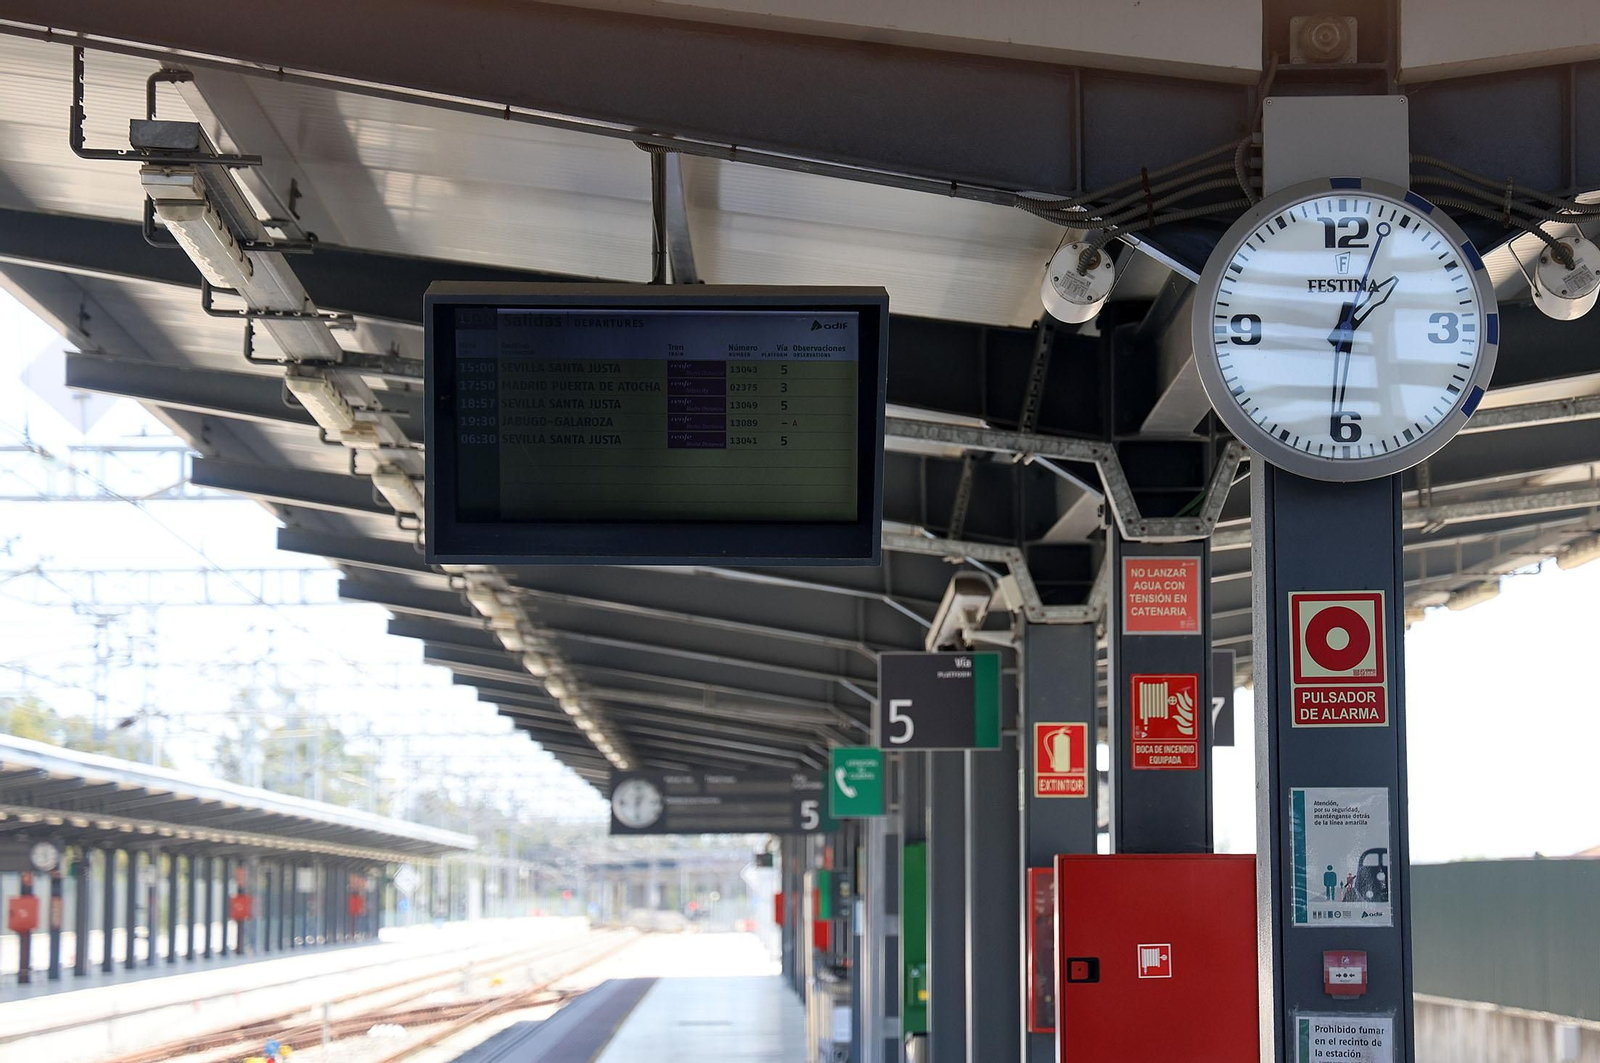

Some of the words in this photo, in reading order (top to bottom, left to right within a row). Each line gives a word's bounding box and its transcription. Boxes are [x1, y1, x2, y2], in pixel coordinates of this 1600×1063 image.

[1317, 217, 1369, 249] 12
[1307, 278, 1380, 293] FESTINA
[503, 312, 562, 327] Salidas
[574, 319, 644, 328] DEPARTURES
[1230, 314, 1262, 345] 9
[1428, 312, 1459, 344] 3
[668, 343, 685, 351] Tren
[728, 342, 758, 351] Número
[792, 343, 846, 351] Observaciones
[459, 362, 495, 373] 15:00
[501, 363, 545, 374] SEVILLA
[550, 363, 583, 374] SANTA
[587, 363, 621, 374] JUSTA
[730, 366, 758, 374] 13043
[780, 364, 788, 375] 5
[460, 381, 495, 391] 17:50
[502, 381, 548, 391] MADRID
[552, 381, 594, 392] PUERTA
[600, 381, 614, 392] DE
[617, 381, 661, 392] ATOCHA
[730, 383, 758, 391] 02375
[780, 382, 788, 393] 3
[460, 399, 495, 409] 18:57
[501, 399, 545, 409] SEVILLA
[550, 399, 584, 410] SANTA
[588, 399, 622, 410] JUSTA
[730, 402, 758, 410] 13049
[780, 400, 788, 411] 5
[460, 417, 496, 427] 19:30
[502, 417, 613, 428] JABUGO-GALAROZA
[730, 420, 758, 428] 13089
[1330, 411, 1362, 443] 6
[461, 434, 496, 444] 06:30
[502, 434, 546, 445] SEVILLA
[550, 434, 585, 445] SANTA
[588, 434, 622, 446] JUSTA
[730, 437, 758, 445] 13041
[780, 436, 788, 446] 5
[1131, 568, 1146, 578] NO
[1147, 568, 1186, 578] LANZAR
[1133, 581, 1162, 590] AGUA
[1164, 581, 1185, 590] CON
[1130, 592, 1171, 603] TENSIÓN
[1174, 593, 1187, 603] EN
[1131, 606, 1187, 616] CATENARIA
[1302, 691, 1377, 704] PULSADOR
[1300, 708, 1319, 720] DE
[1321, 707, 1379, 720] ALARMA
[888, 698, 915, 744] 5
[1136, 745, 1154, 754] BOCA
[1155, 745, 1162, 754] DE
[1163, 745, 1195, 754] INCENDIO
[1149, 755, 1182, 765] EQUIPADA
[1038, 779, 1084, 792] EXTINTOR
[800, 799, 820, 830] 5
[1314, 1025, 1356, 1034] Prohibido
[1359, 1025, 1385, 1035] fumar
[1328, 1037, 1336, 1045] el
[1339, 1037, 1369, 1047] recinto
[1371, 1038, 1382, 1047] de
[1315, 1048, 1323, 1057] la
[1325, 1049, 1361, 1058] estación
